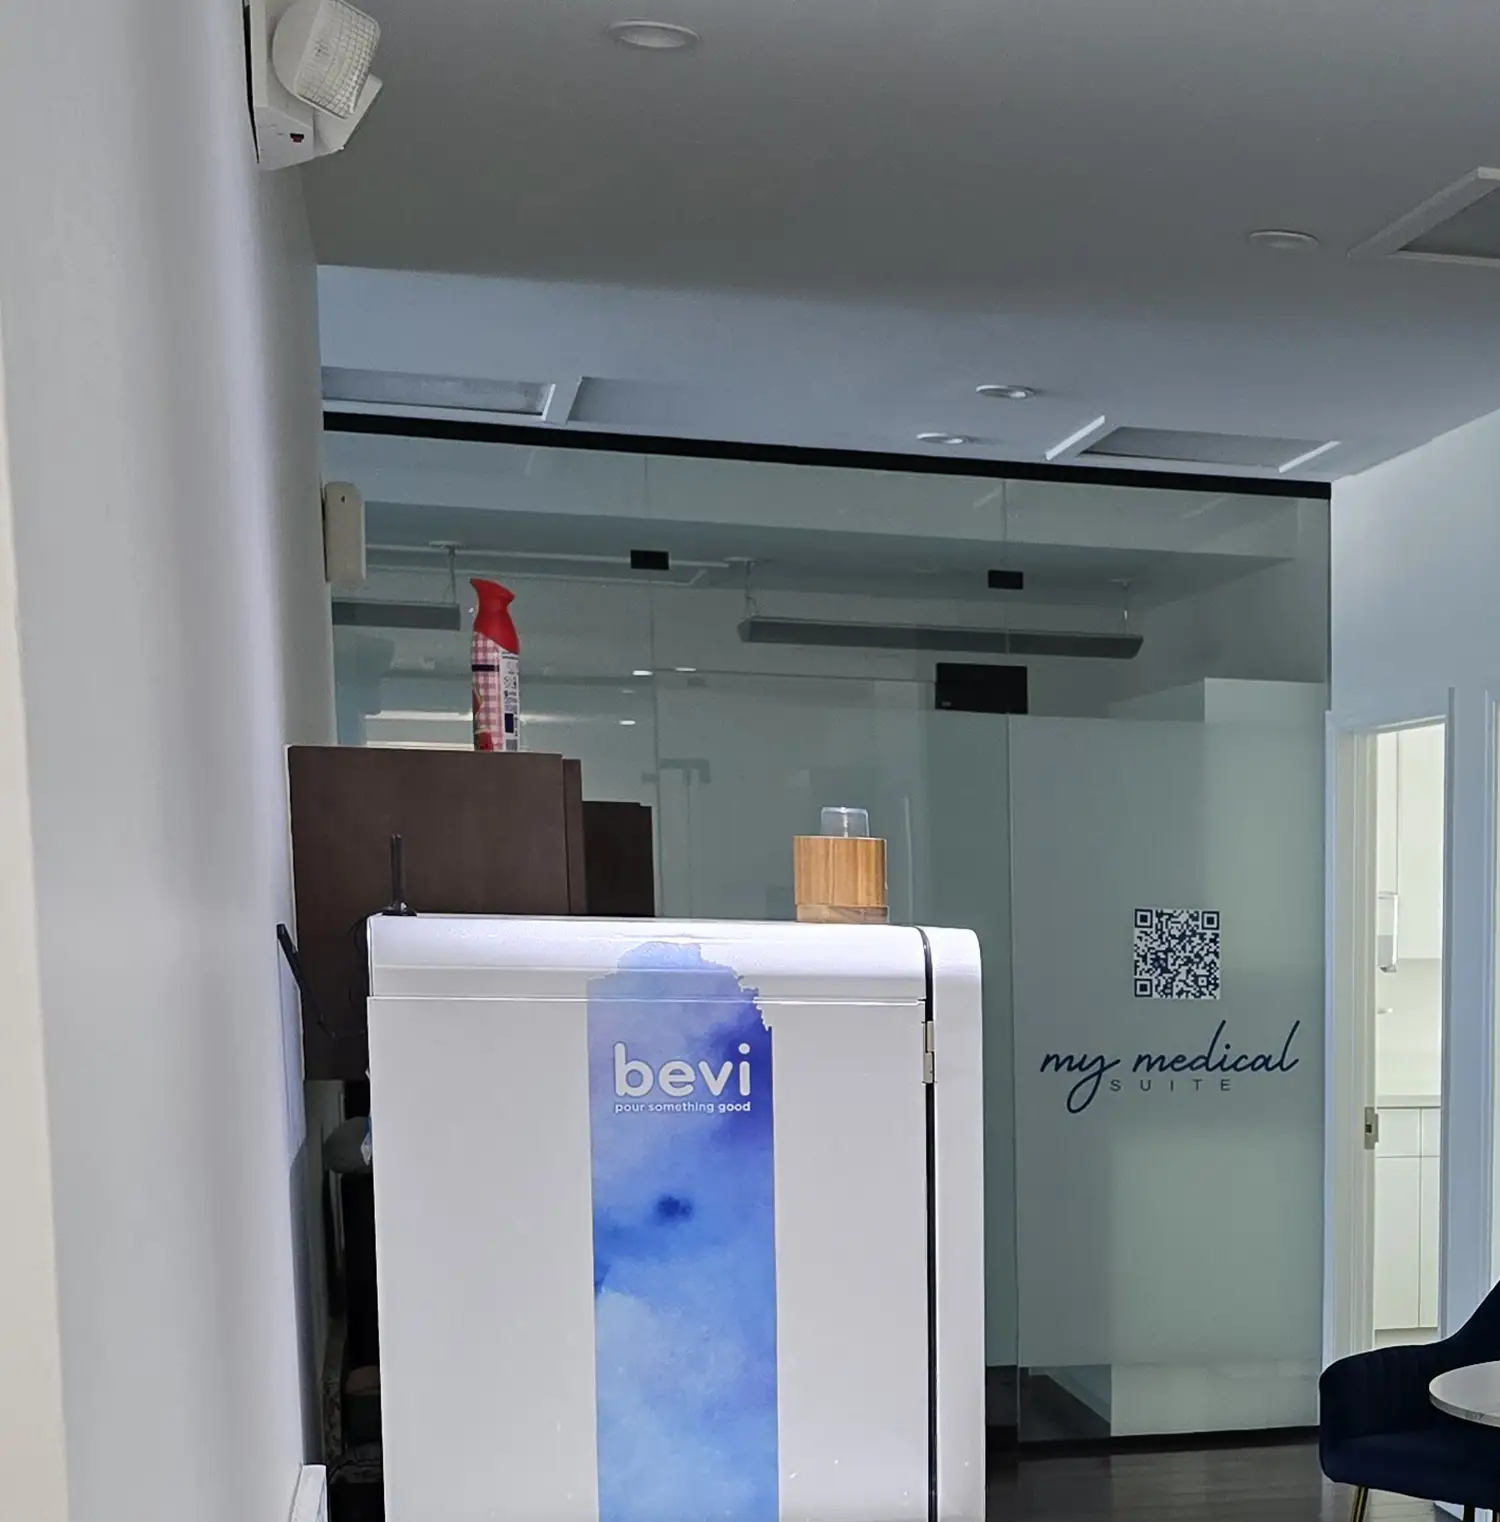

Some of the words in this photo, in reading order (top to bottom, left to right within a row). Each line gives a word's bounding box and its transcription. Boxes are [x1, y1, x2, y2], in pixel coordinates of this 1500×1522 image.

[614, 1042, 751, 1097] bevi
[1040, 1053, 1121, 1114] my
[1132, 1019, 1300, 1072] medical
[1110, 1079, 1231, 1092] SUITE
[615, 1103, 644, 1113] pour
[649, 1102, 715, 1113] something
[718, 1102, 751, 1113] good
